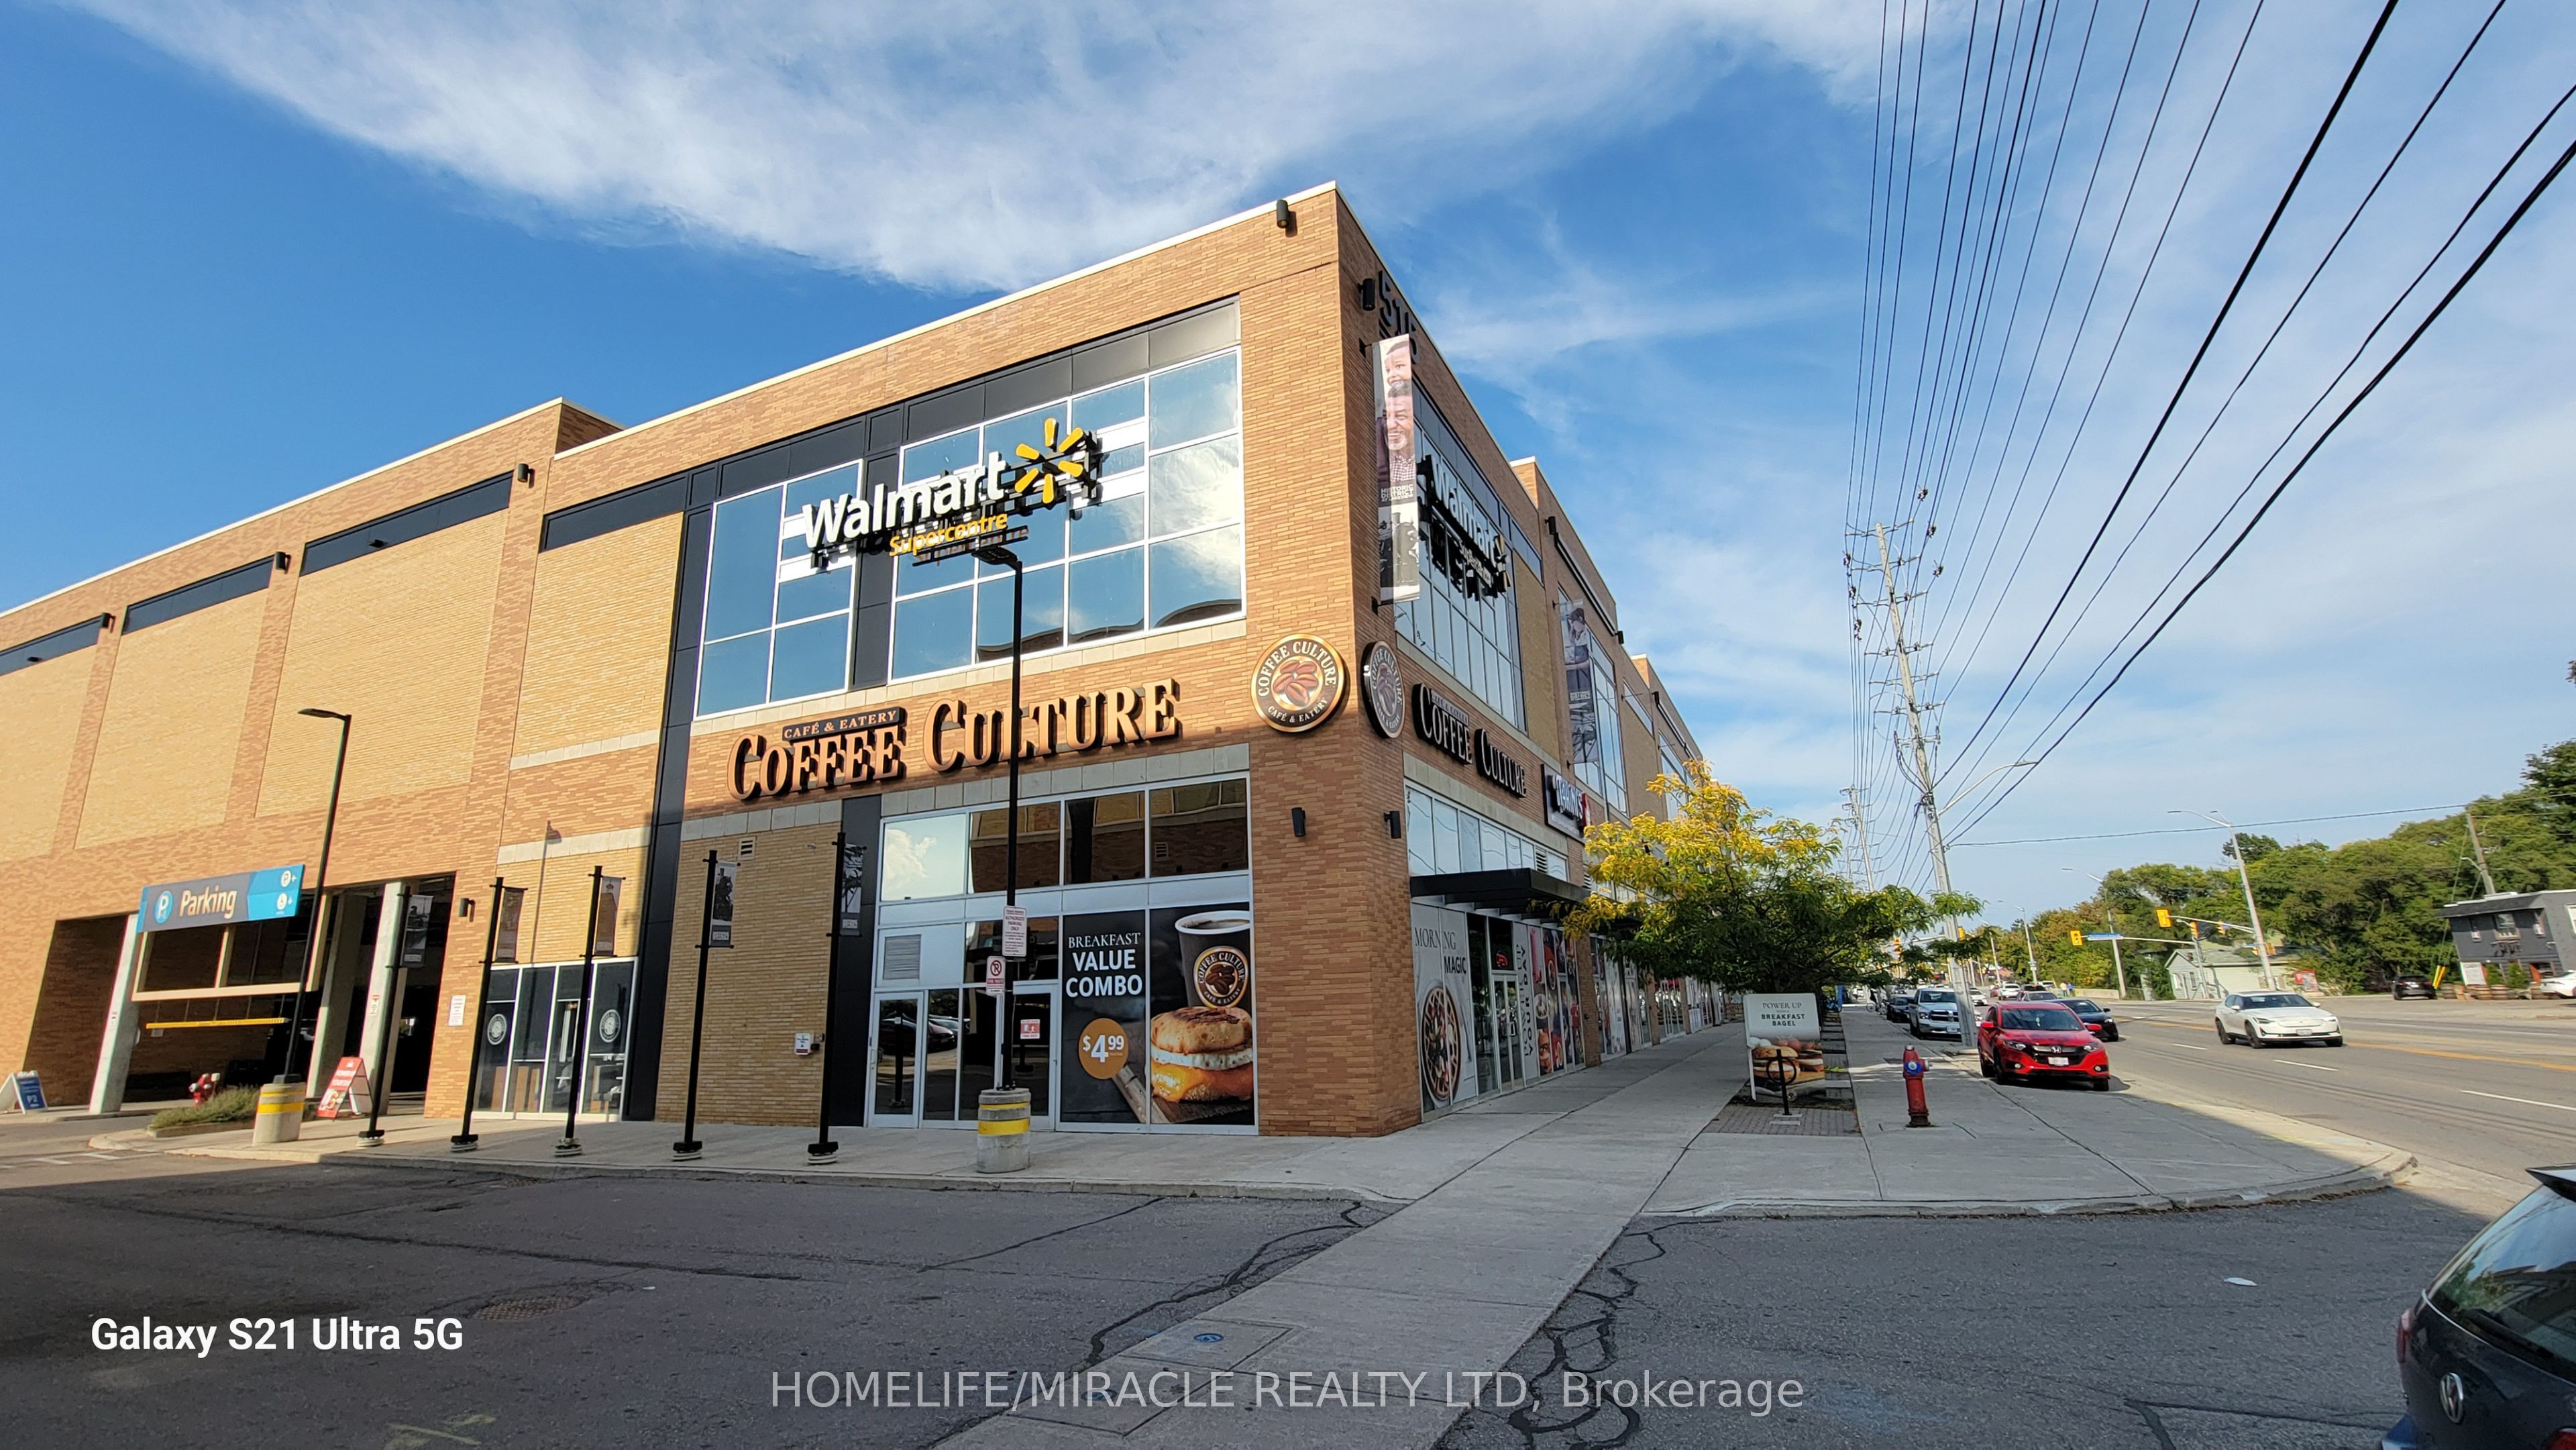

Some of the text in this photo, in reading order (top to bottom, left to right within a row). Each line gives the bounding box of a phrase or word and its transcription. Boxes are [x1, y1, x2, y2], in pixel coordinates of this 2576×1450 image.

[803, 451, 1007, 549] Walmart
[1431, 453, 1497, 568] Walmart
[889, 512, 1008, 557] Supercentre
[1257, 641, 1337, 697] COFFEE CULTURE
[784, 710, 897, 739] CAFÉ & EATERY
[1267, 697, 1328, 723] CAFÉ & EATERY
[727, 678, 1177, 800] COFFEE CULTURE
[1419, 683, 1472, 765] COFFEE
[1481, 729, 1527, 796] CULTURE
[179, 886, 237, 919] Parking
[1068, 932, 1141, 949] BREAKFAST
[1414, 927, 1456, 950] MORNNG
[1072, 949, 1136, 972] VALUE
[1198, 952, 1245, 984] COFFEE CULTURE
[1444, 956, 1466, 974] MAGIC
[1065, 974, 1143, 998] COMBO
[1525, 996, 1534, 1056] YOUR
